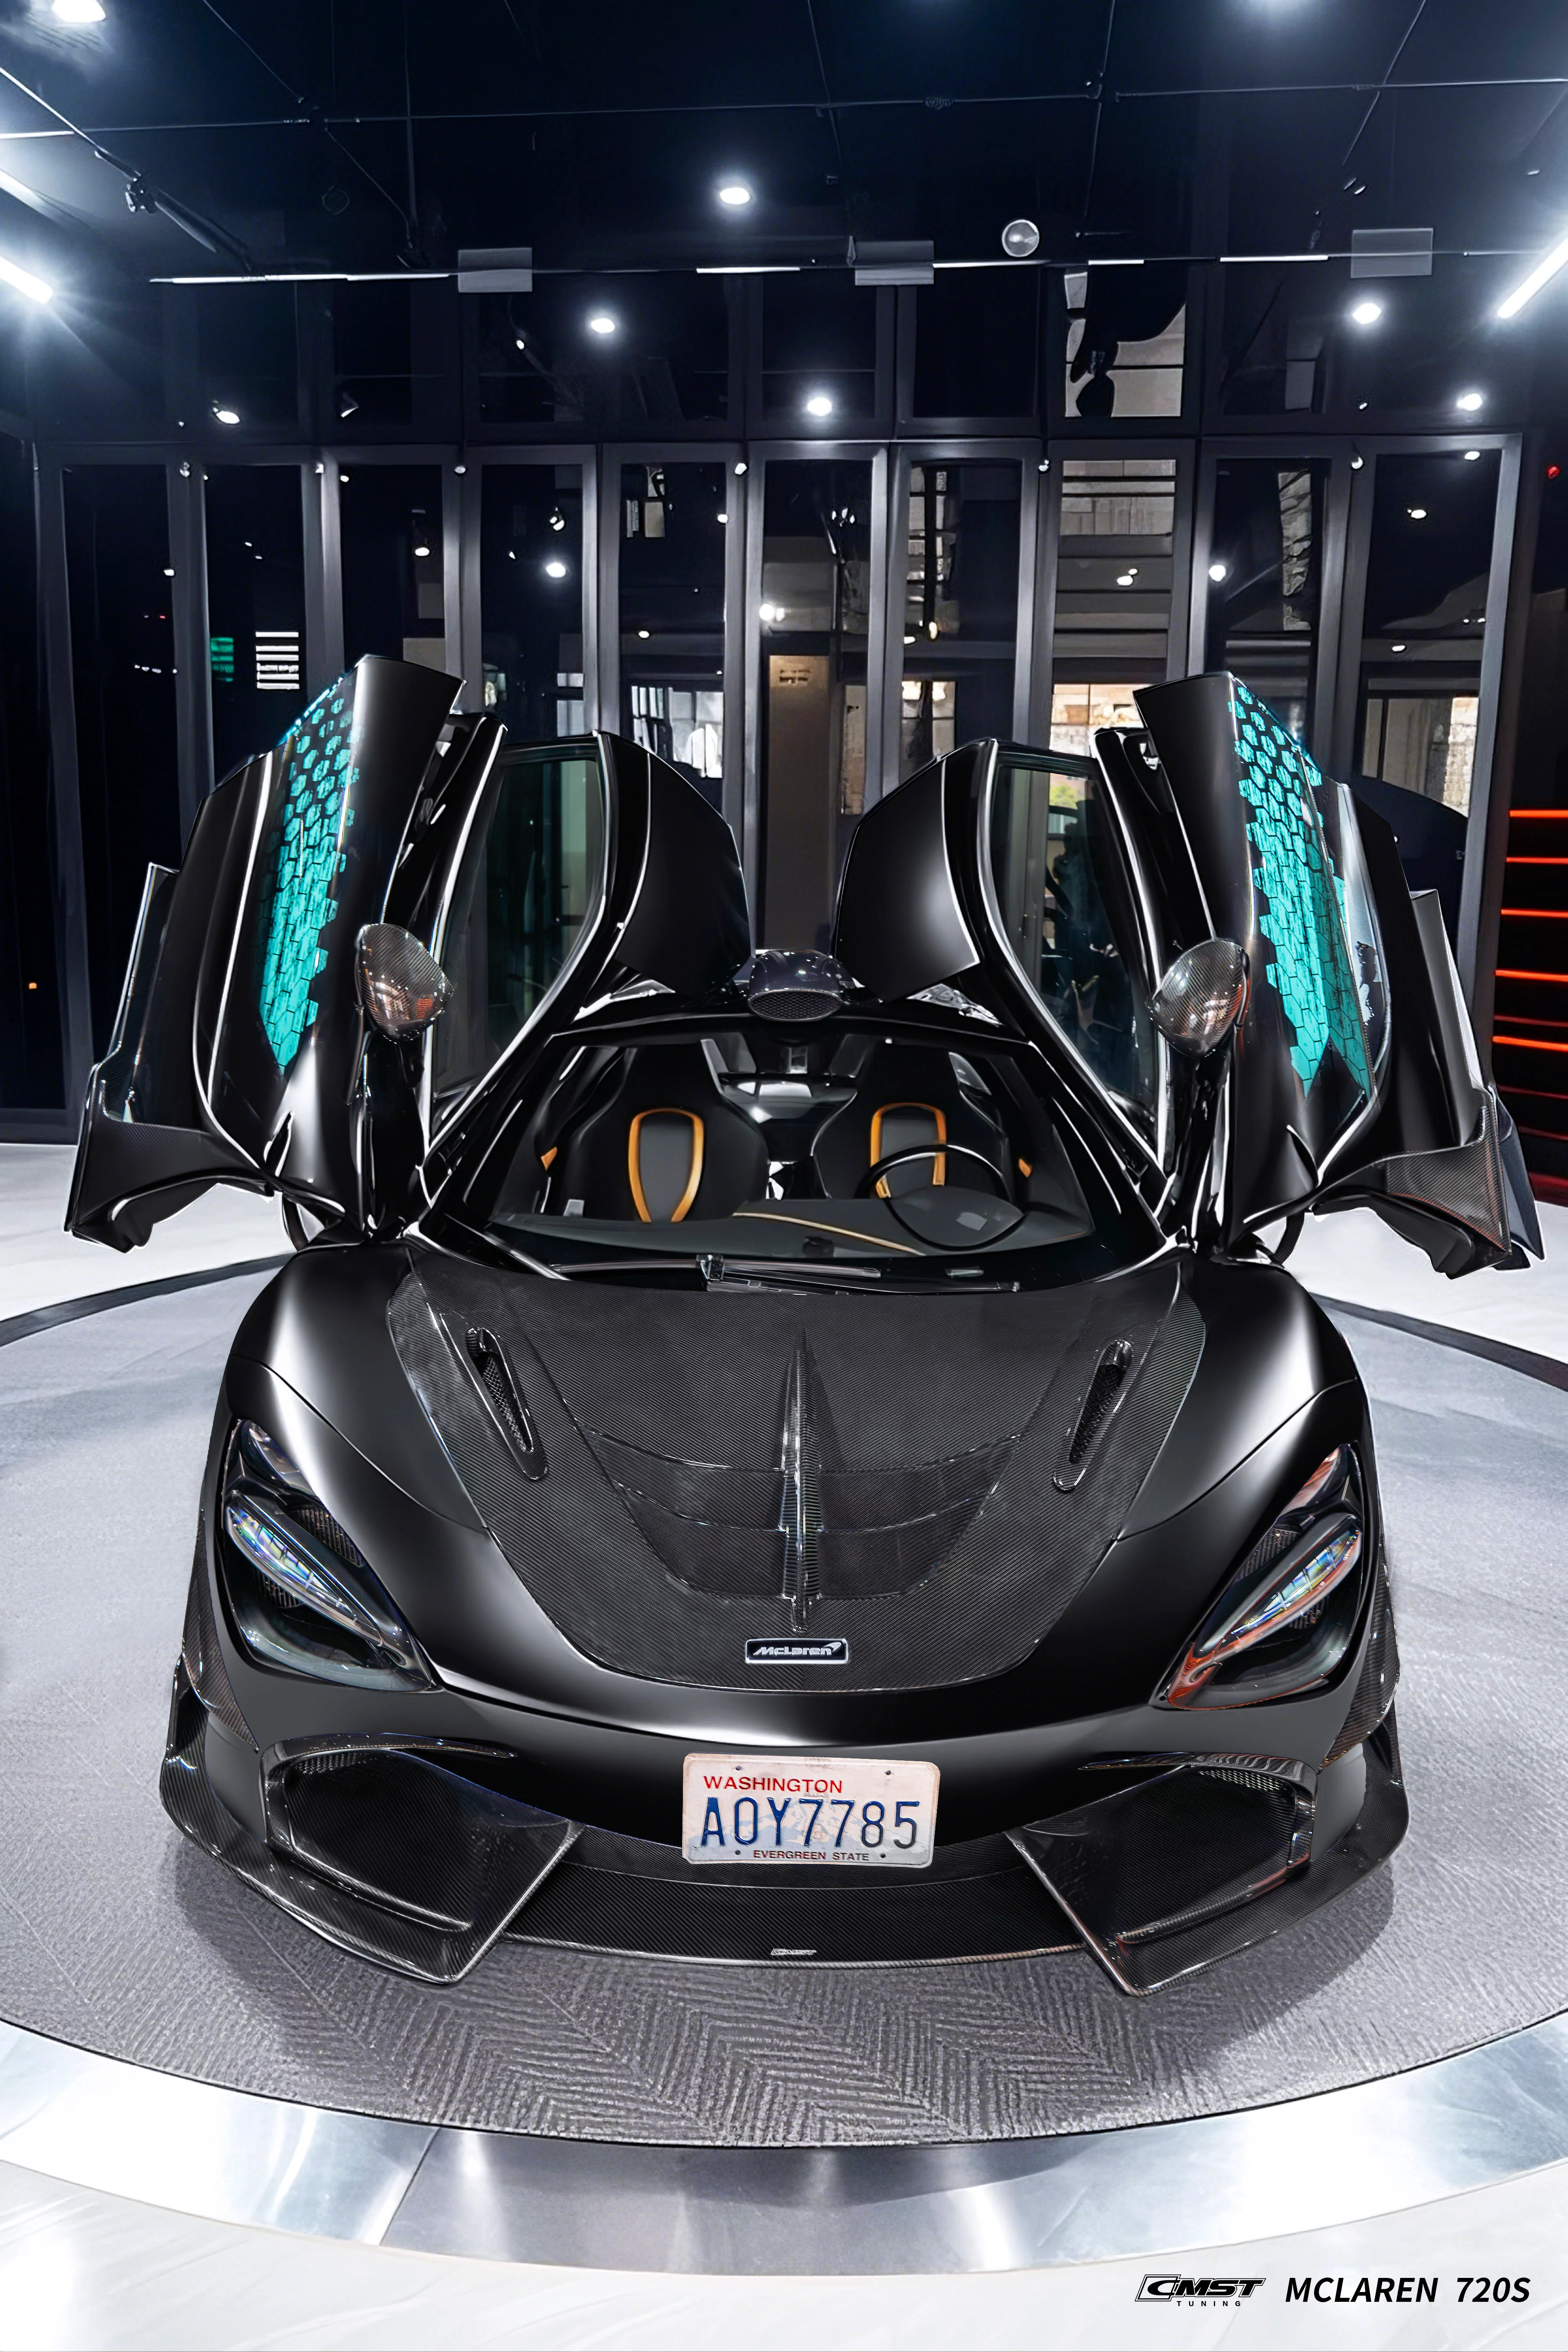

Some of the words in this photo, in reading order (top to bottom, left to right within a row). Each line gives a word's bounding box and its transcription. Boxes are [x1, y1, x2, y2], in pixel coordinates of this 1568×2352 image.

[753, 1646, 832, 1656] McLaren
[703, 1776, 842, 1793] WASHINGTON
[753, 1850, 826, 1860] EVERGREEN
[833, 1852, 869, 1861] STATE
